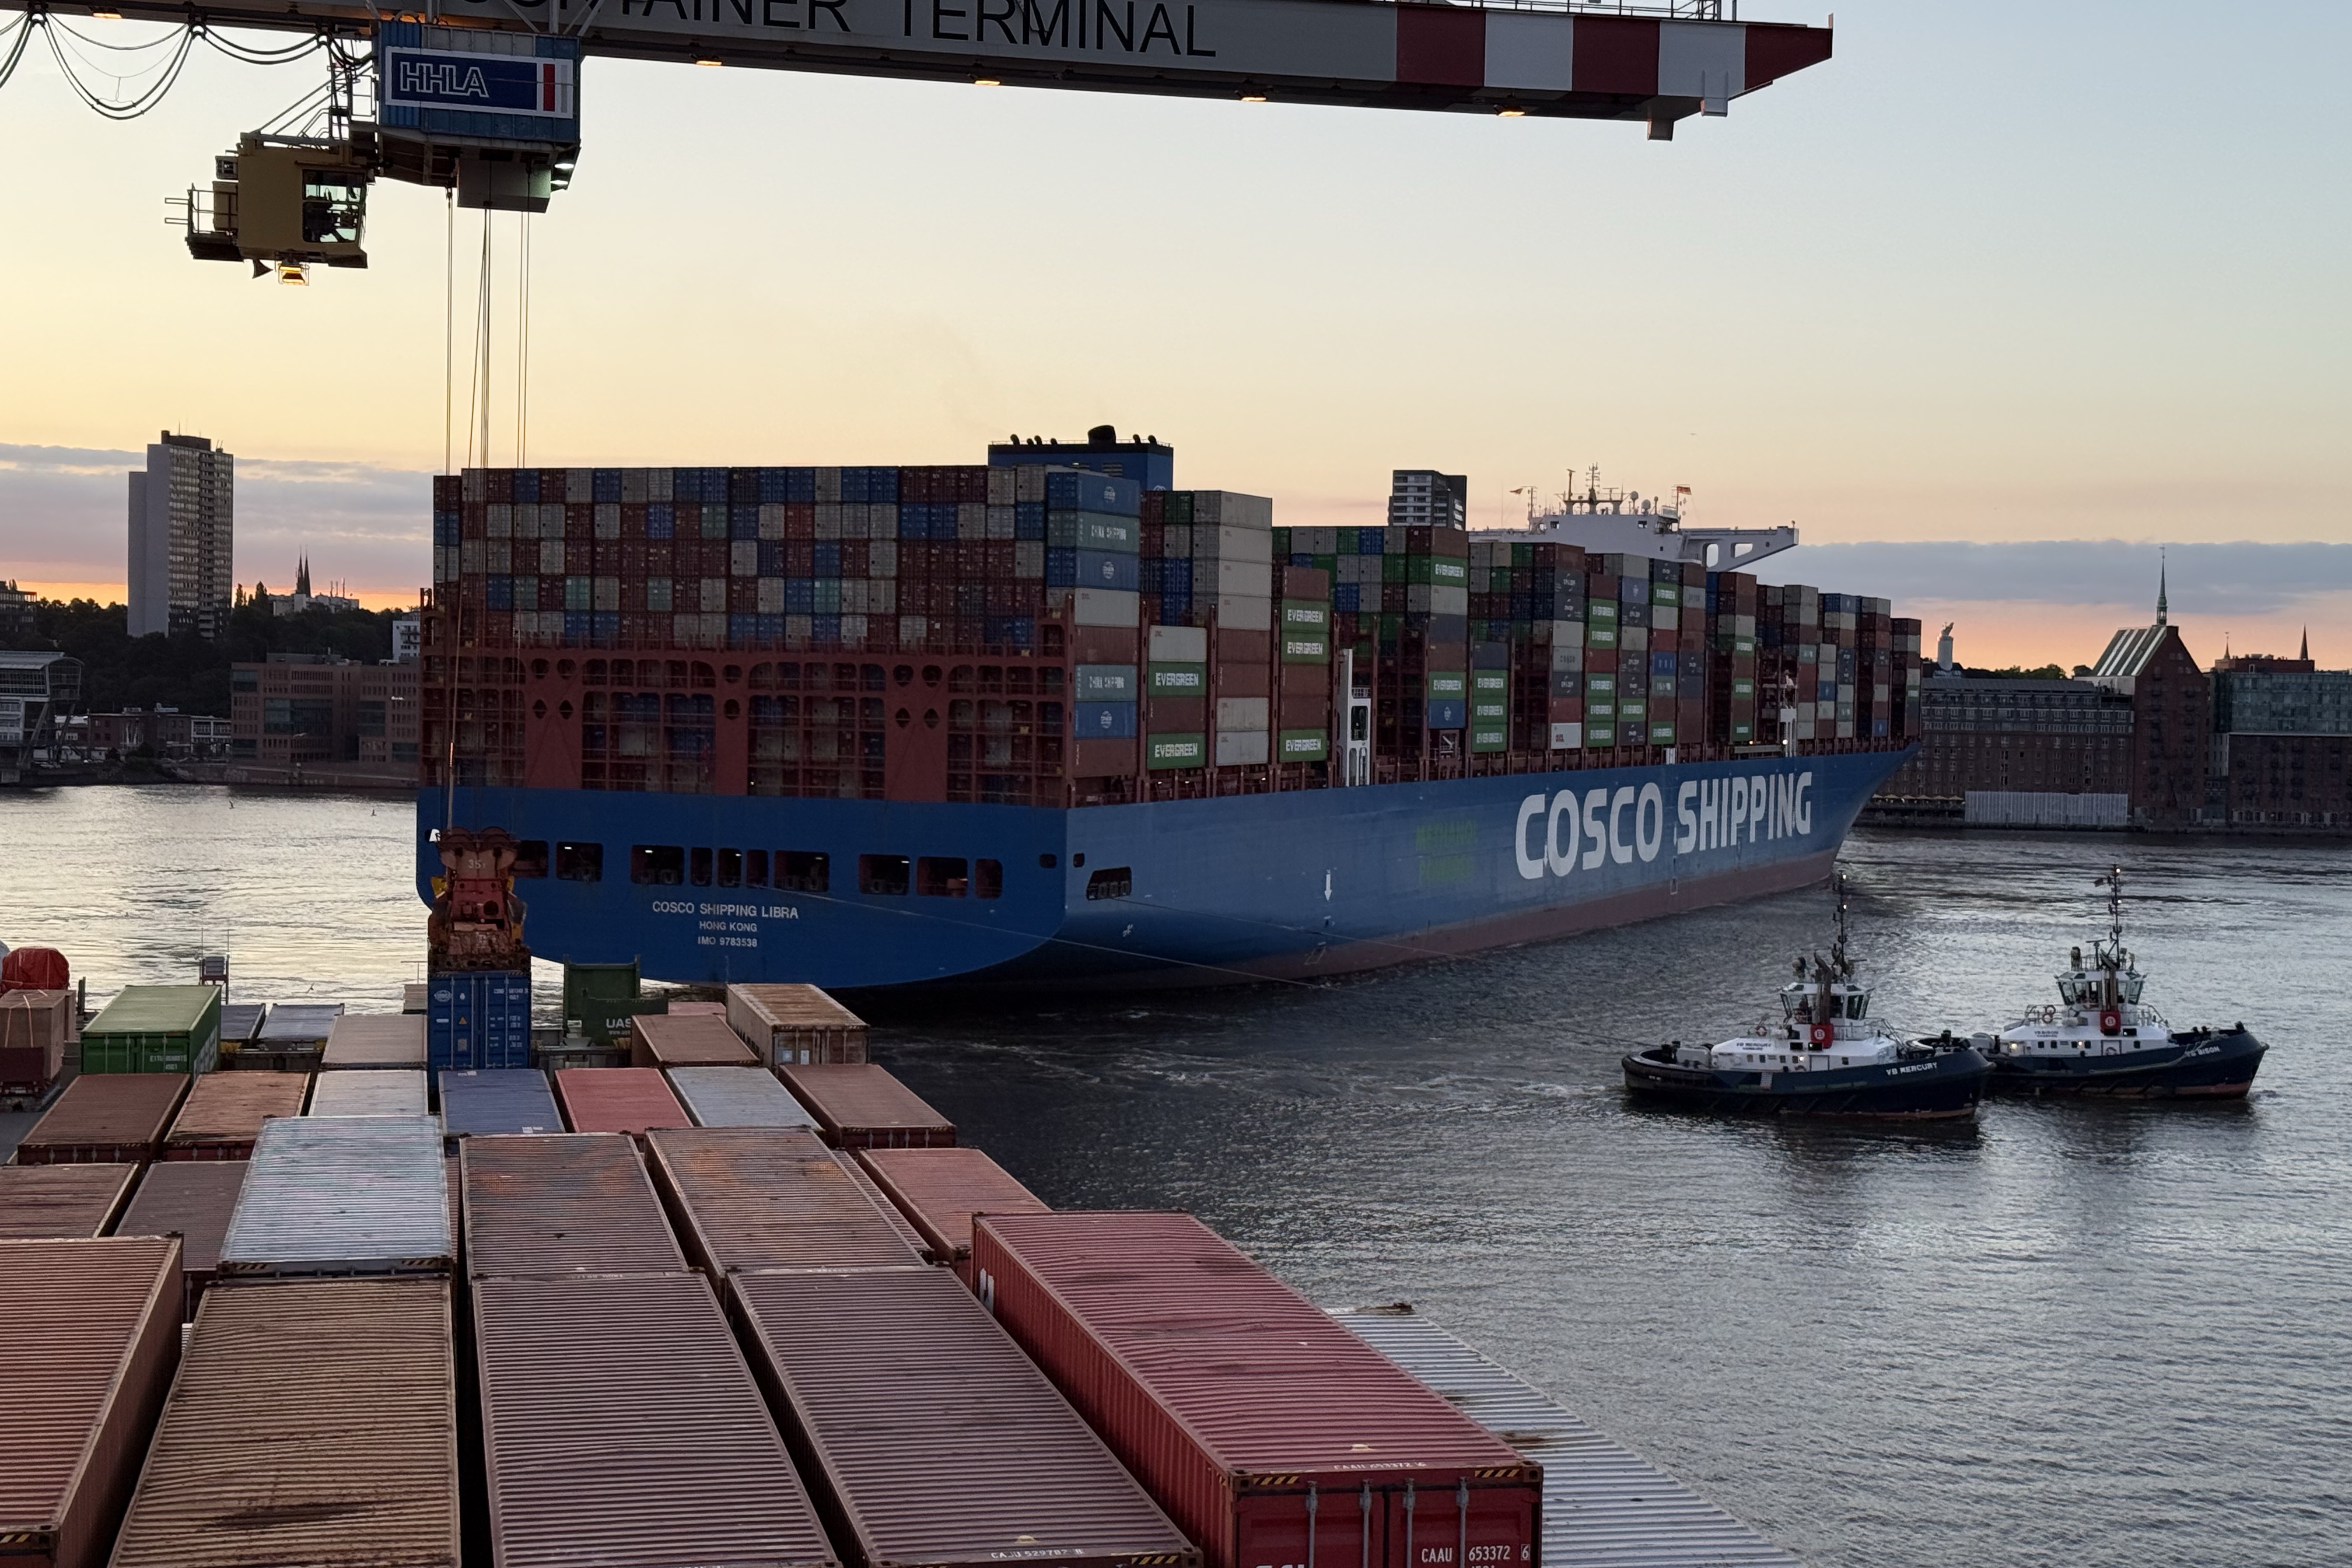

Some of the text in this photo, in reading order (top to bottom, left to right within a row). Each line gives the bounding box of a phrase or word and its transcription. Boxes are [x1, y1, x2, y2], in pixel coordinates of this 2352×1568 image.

[904, 0, 1216, 57] TERMINAL
[400, 62, 489, 98] HHLA
[1435, 564, 1464, 578] EVERGREEN
[1287, 609, 1324, 623] EVERGREEN
[1287, 642, 1323, 655] EVERGREEN
[1156, 672, 1199, 686] EVERGREEN
[1433, 680, 1462, 691] EVERGREEN
[1154, 743, 1198, 758] EVERGREEN
[1286, 738, 1322, 752] EVERGREEN
[1516, 772, 1812, 879] COSCO SHIPPING
[652, 901, 799, 919] COSCO SHIPPING LIBRA
[699, 921, 758, 932] HONG KONG
[698, 936, 758, 948] IMO 9783538
[2197, 1046, 2220, 1055] BISON
[1899, 1062, 1938, 1074] MERCURY
[1422, 1545, 1530, 1563] CAAU 653372 6
